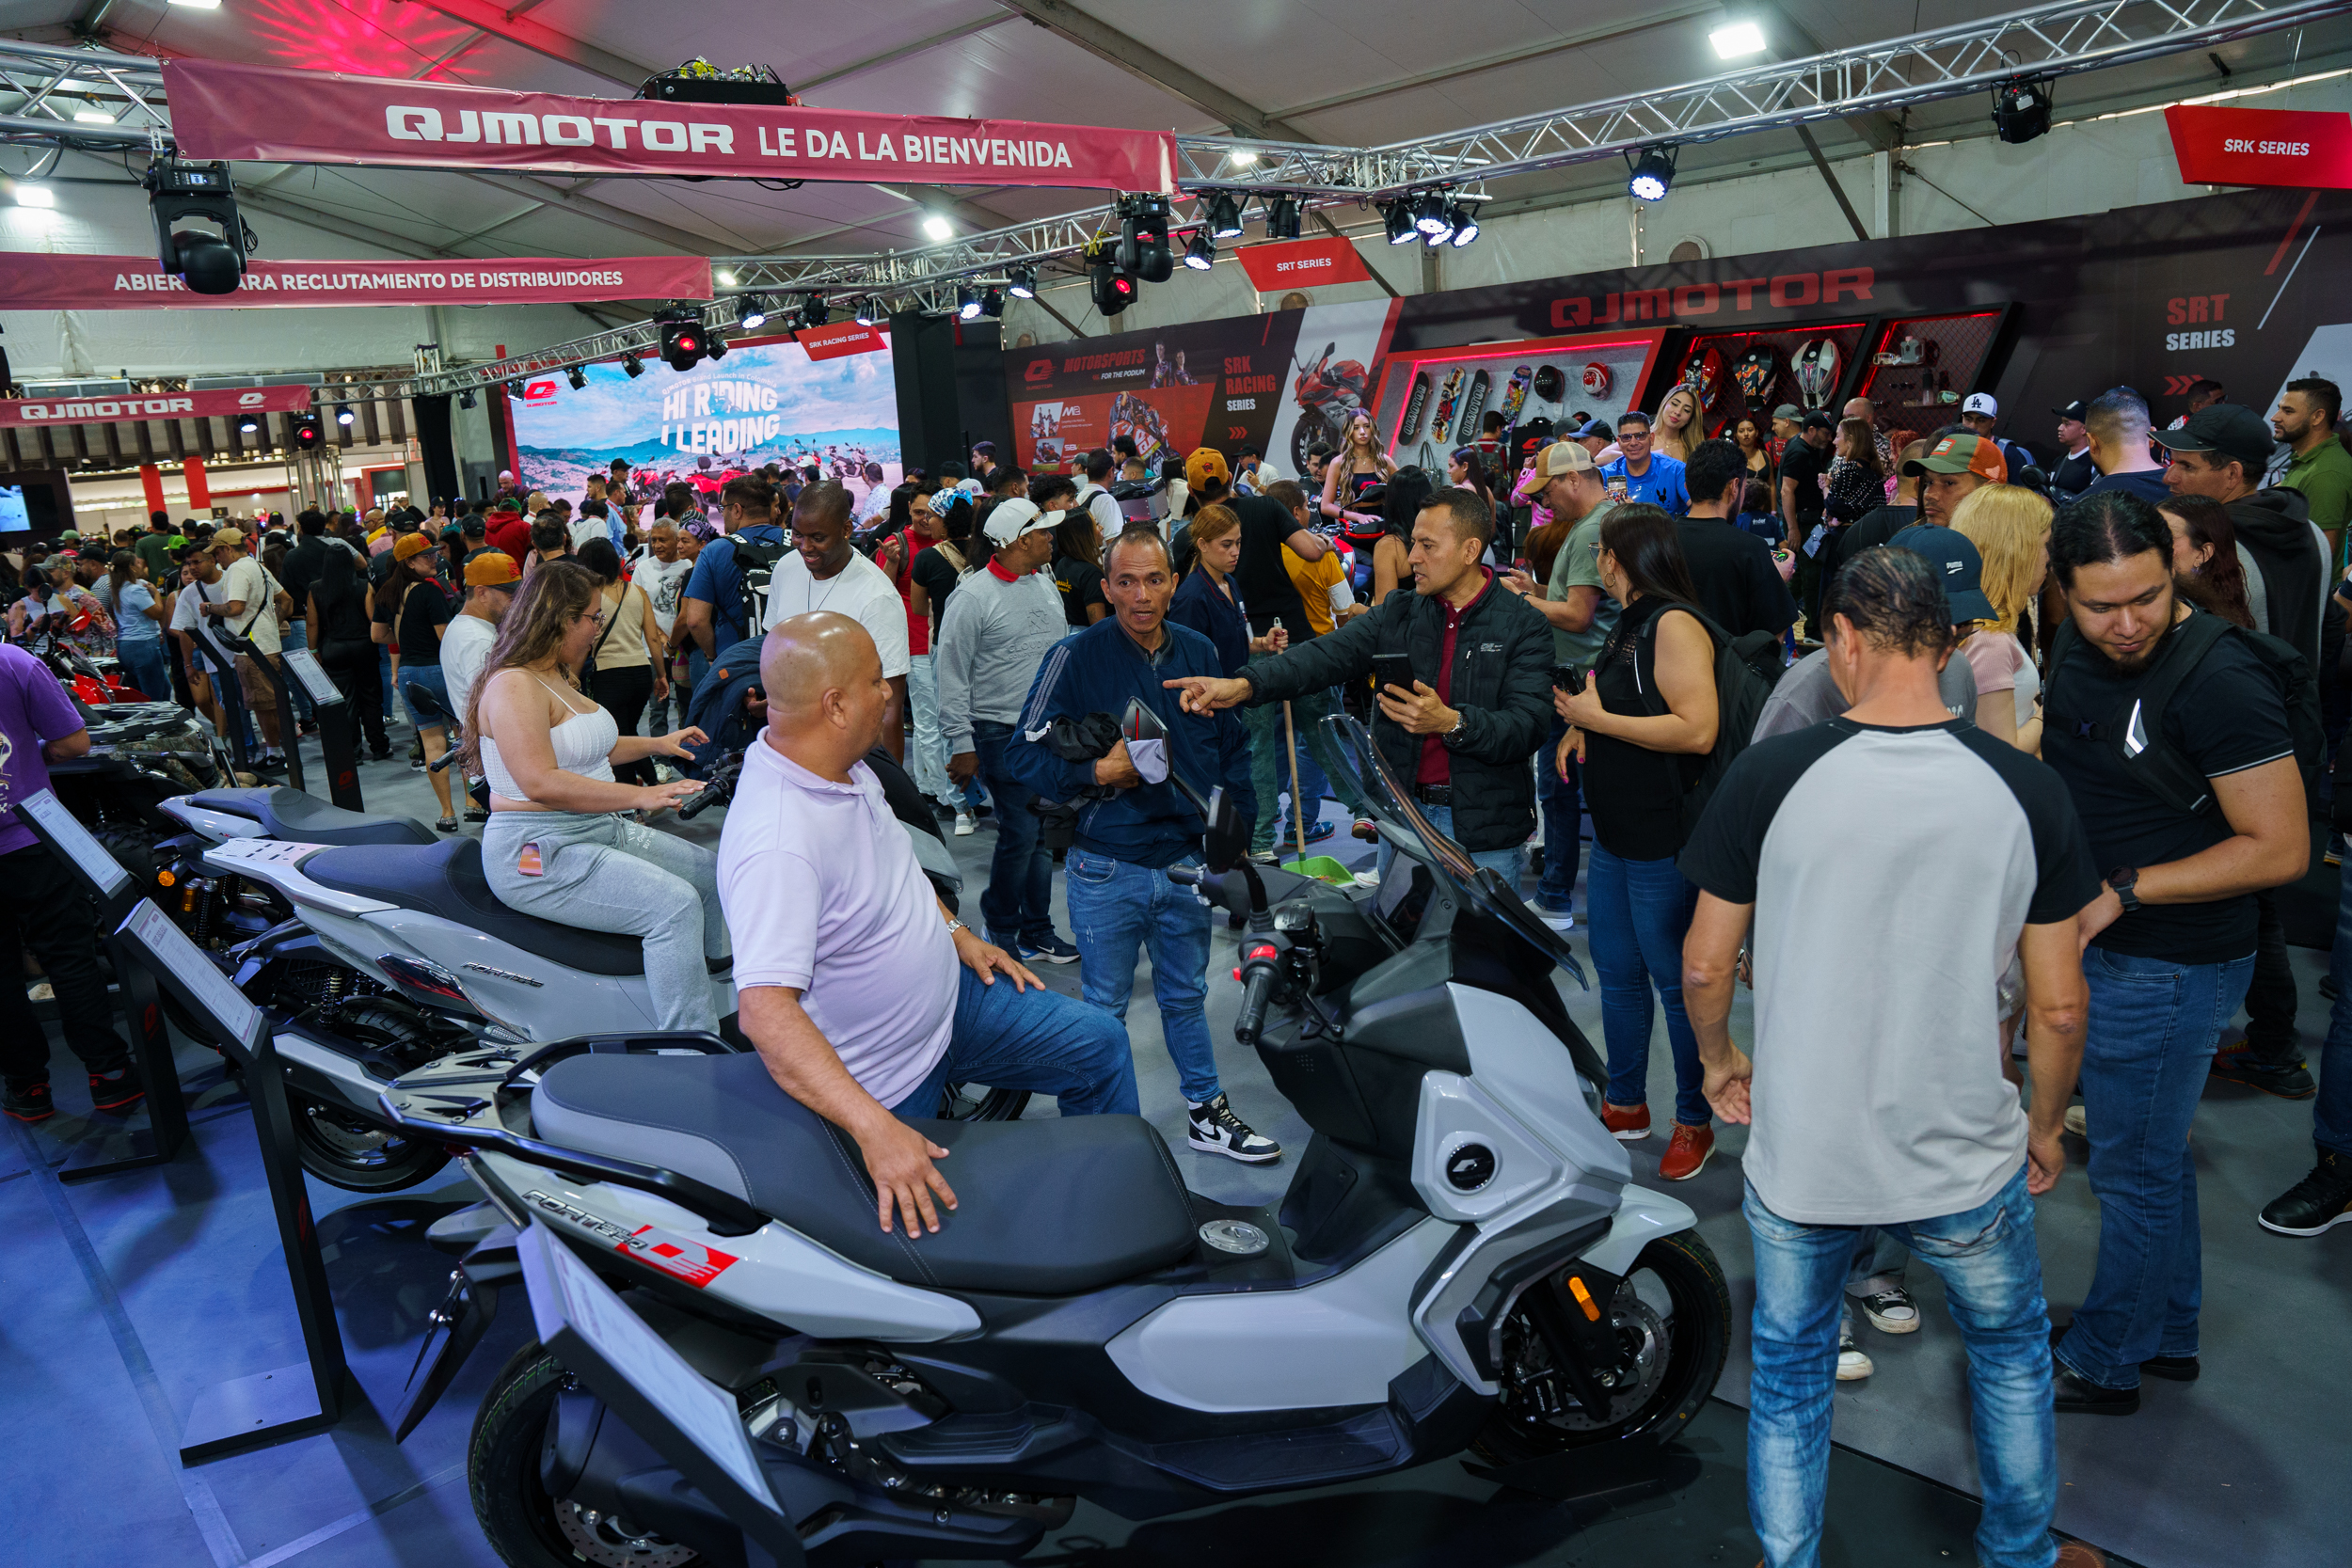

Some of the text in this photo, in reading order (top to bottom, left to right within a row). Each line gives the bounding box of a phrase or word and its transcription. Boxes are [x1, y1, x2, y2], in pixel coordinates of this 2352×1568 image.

[386, 104, 1073, 168] QJMOTOR LE DA LA BIENVENIDA
[2224, 138, 2311, 156] SRK SERIES
[1277, 258, 1332, 272] SRT SERIES
[114, 271, 623, 291] ABIER ARA RECLUTAMIENTO DE DISTRIBUIDORES
[1550, 266, 1875, 328] QJMOTOR
[2167, 293, 2231, 325] SRT
[809, 332, 869, 349] SRK RACING SERIES
[2166, 328, 2235, 351] SERIES
[1063, 348, 1146, 373] MOTORSPORTS
[1224, 356, 1251, 374] SRK
[661, 378, 691, 395] QJMOTOR
[692, 372, 712, 383] Brand
[746, 373, 778, 388] Colombia
[1101, 372, 1112, 380] FOR
[1123, 368, 1146, 377] PODIUM
[1225, 374, 1277, 395] RACING
[20, 397, 194, 420] QJMOTOR
[662, 388, 688, 421] HI
[1226, 398, 1256, 412] SERIES
[675, 414, 781, 454] LEADING
